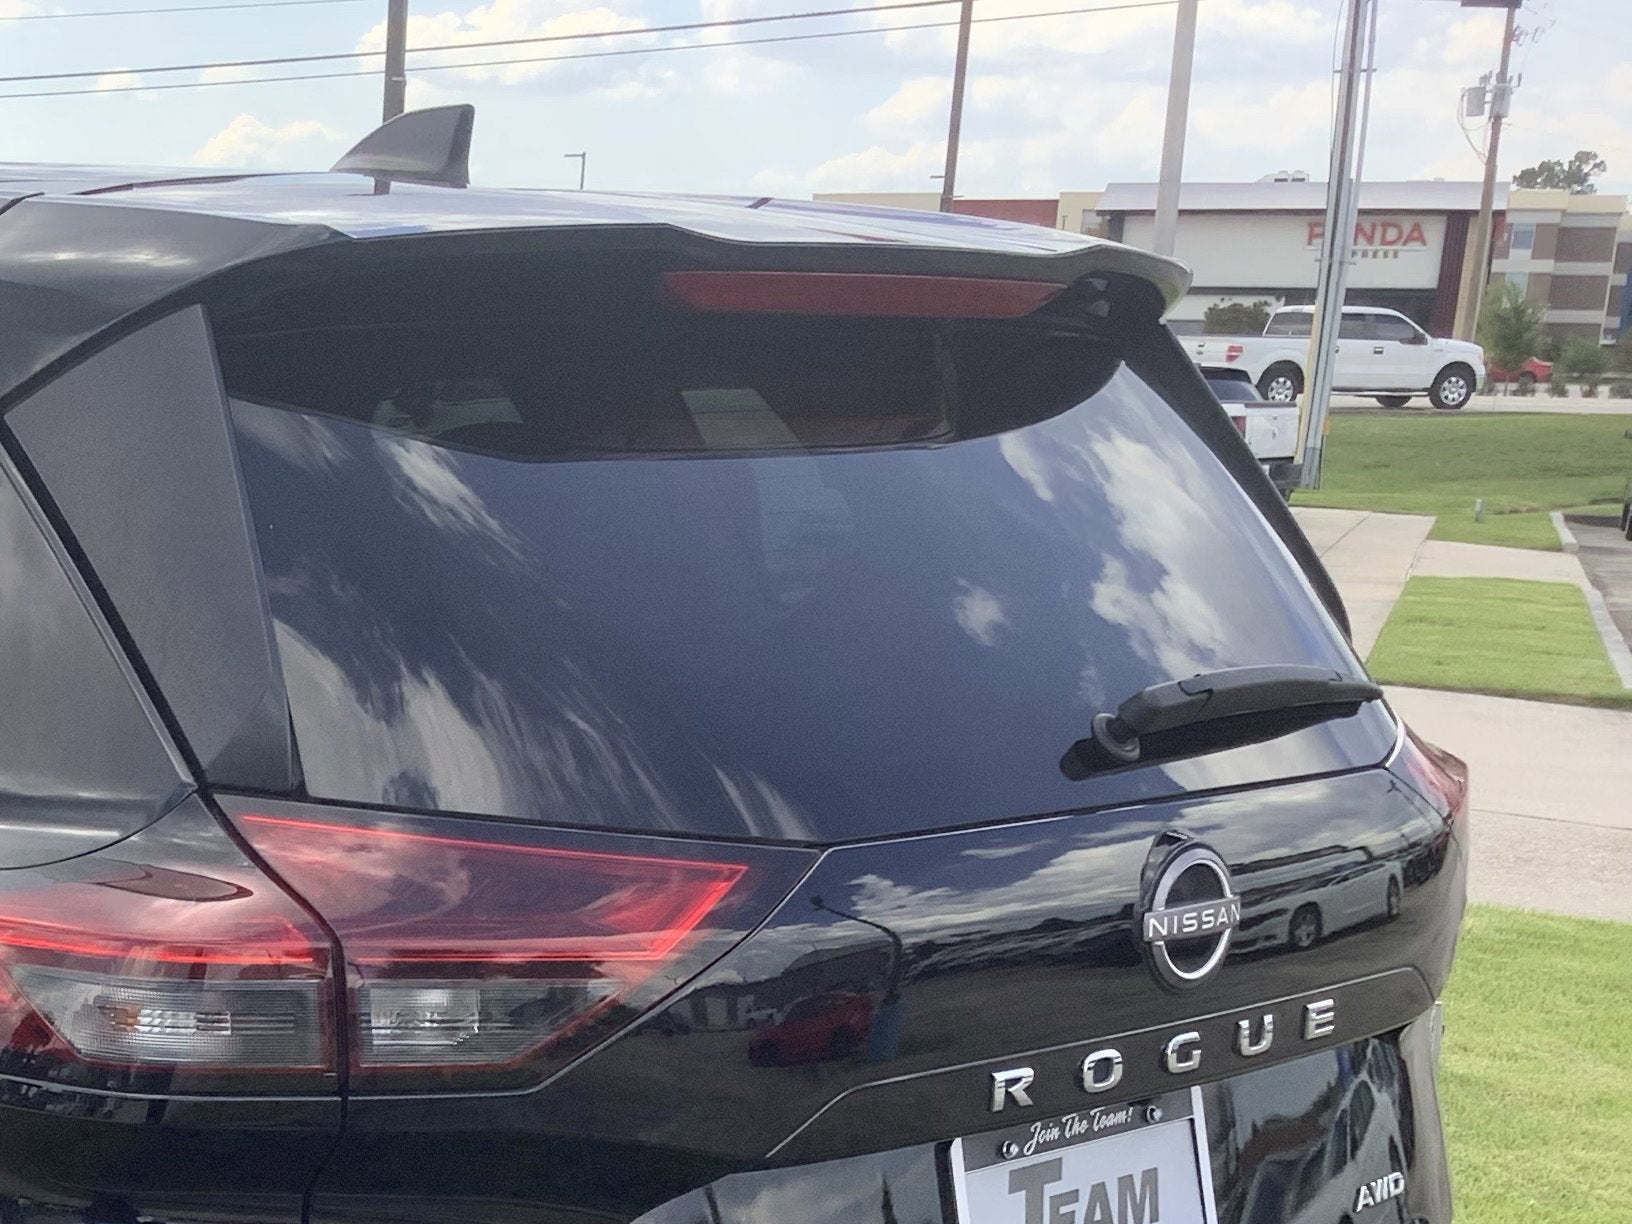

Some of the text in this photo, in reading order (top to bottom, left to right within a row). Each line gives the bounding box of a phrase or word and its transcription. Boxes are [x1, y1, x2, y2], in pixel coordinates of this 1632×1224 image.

[1307, 221, 1427, 246] PNDA
[1148, 901, 1241, 938] NISSAN
[989, 998, 1336, 1113] ROGUE
[1023, 1106, 1134, 1156] Join The Team!
[1353, 1171, 1405, 1213] AWD
